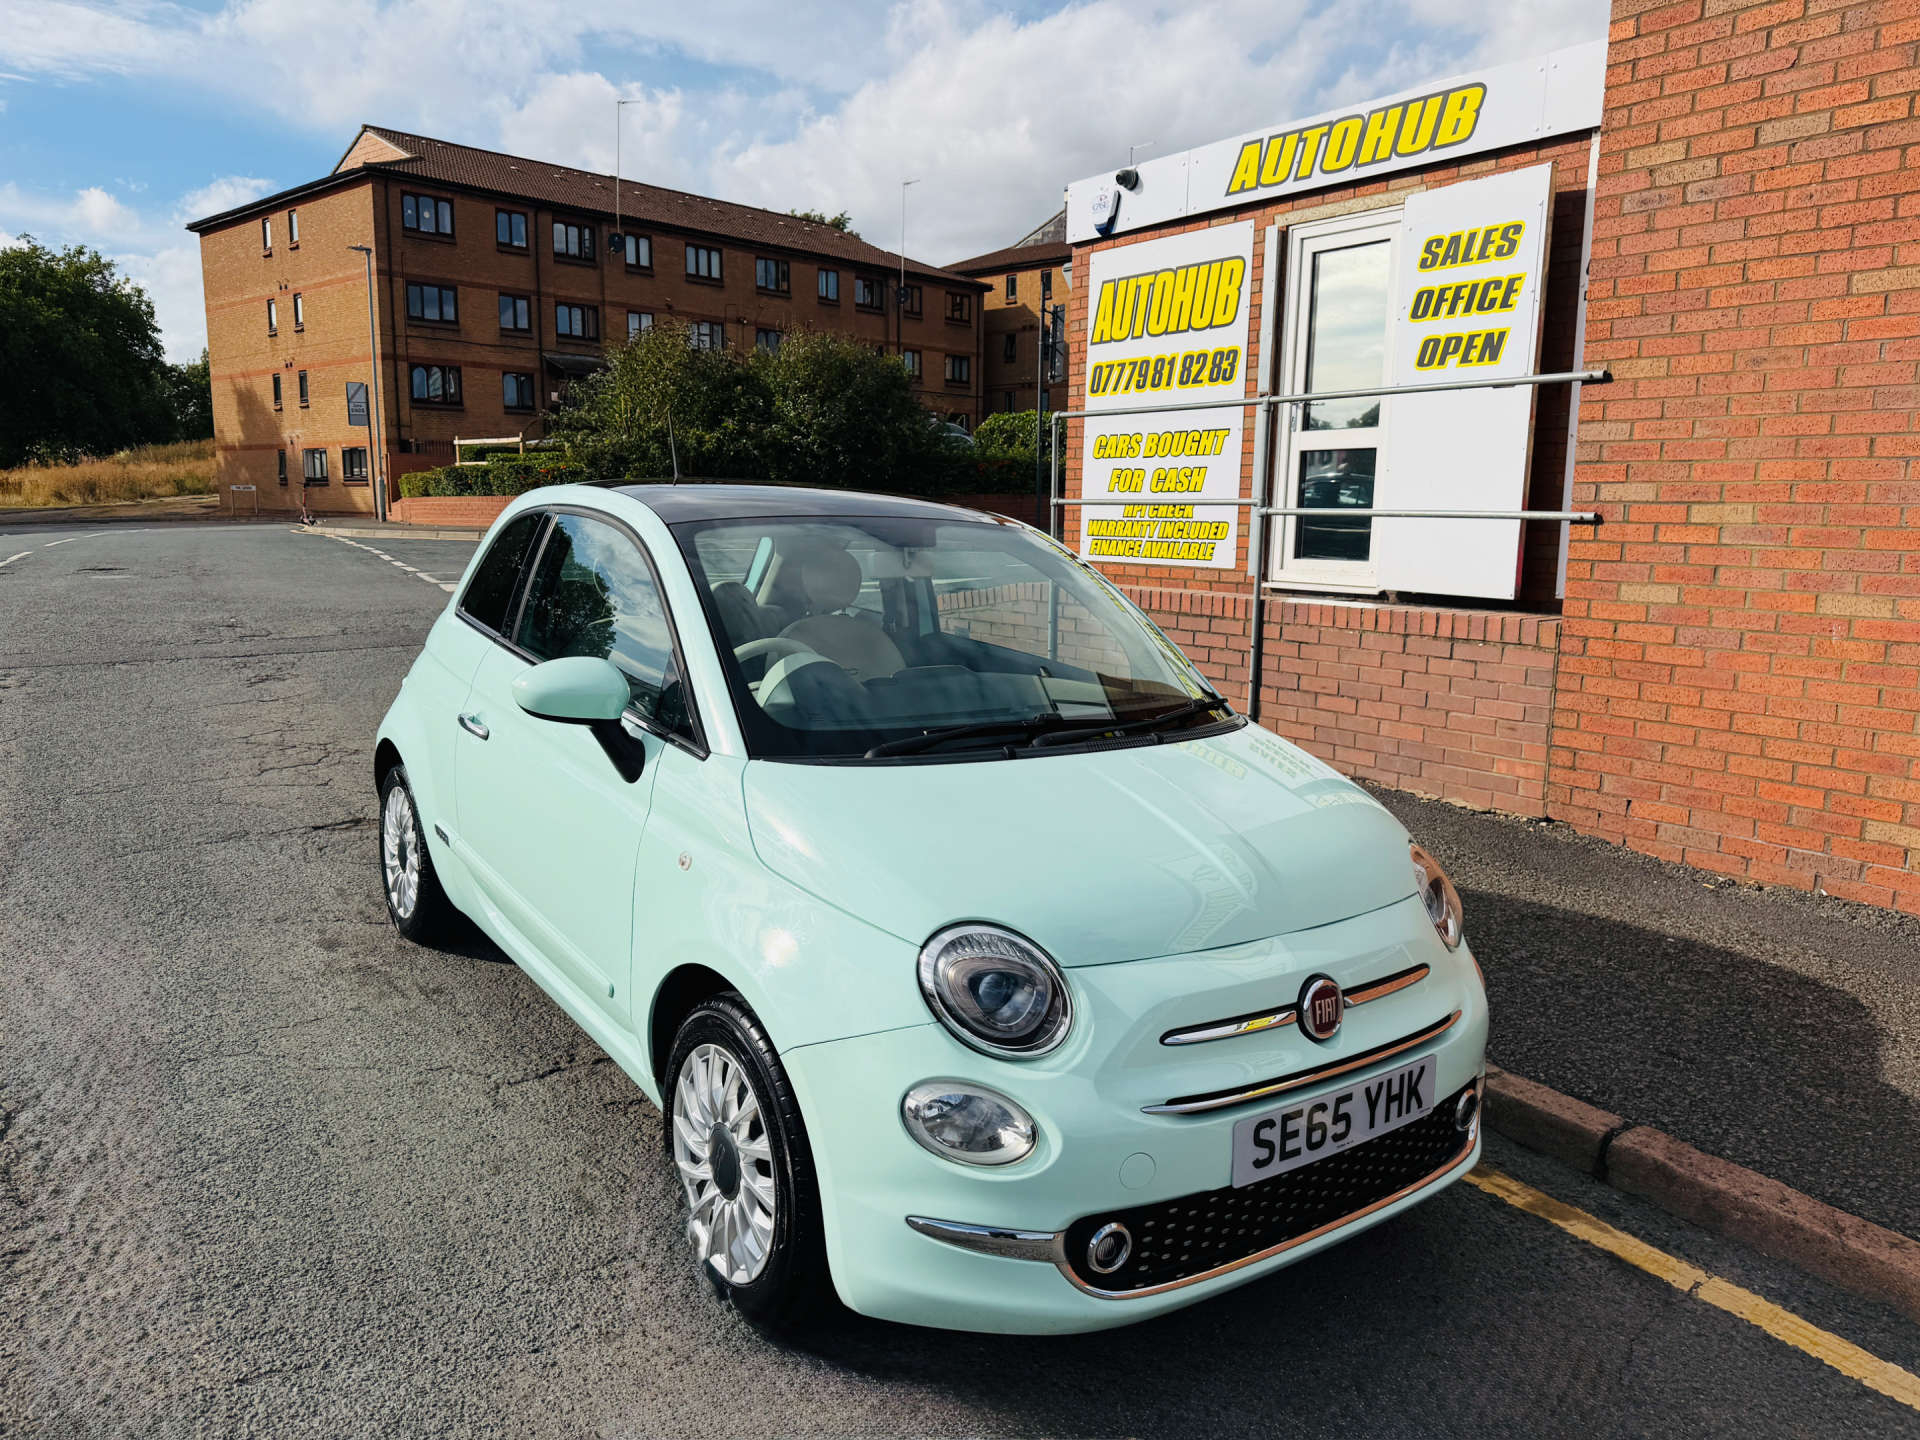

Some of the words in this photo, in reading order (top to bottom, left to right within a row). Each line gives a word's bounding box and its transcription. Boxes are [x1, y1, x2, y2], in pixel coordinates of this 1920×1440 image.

[1225, 82, 1487, 197] AUTOHUB
[1417, 220, 1526, 272] SALES
[1090, 256, 1246, 345] AUTOHUB
[1408, 272, 1527, 323] OFFICE
[1415, 327, 1512, 371] OPEN
[1092, 433, 1143, 459] CARS
[1142, 428, 1230, 458] BOUGHT
[1108, 468, 1145, 493] FOR
[1150, 467, 1208, 493] CASH
[1087, 519, 1160, 538] WARRANTY
[1157, 520, 1230, 541] INCLUDED
[1088, 538, 1143, 558] FINANCE
[1140, 540, 1217, 561] AVAILABLE
[1316, 995, 1337, 1025] FIAT
[1252, 1092, 1353, 1169] SE65
[1364, 1065, 1426, 1130] YHK
